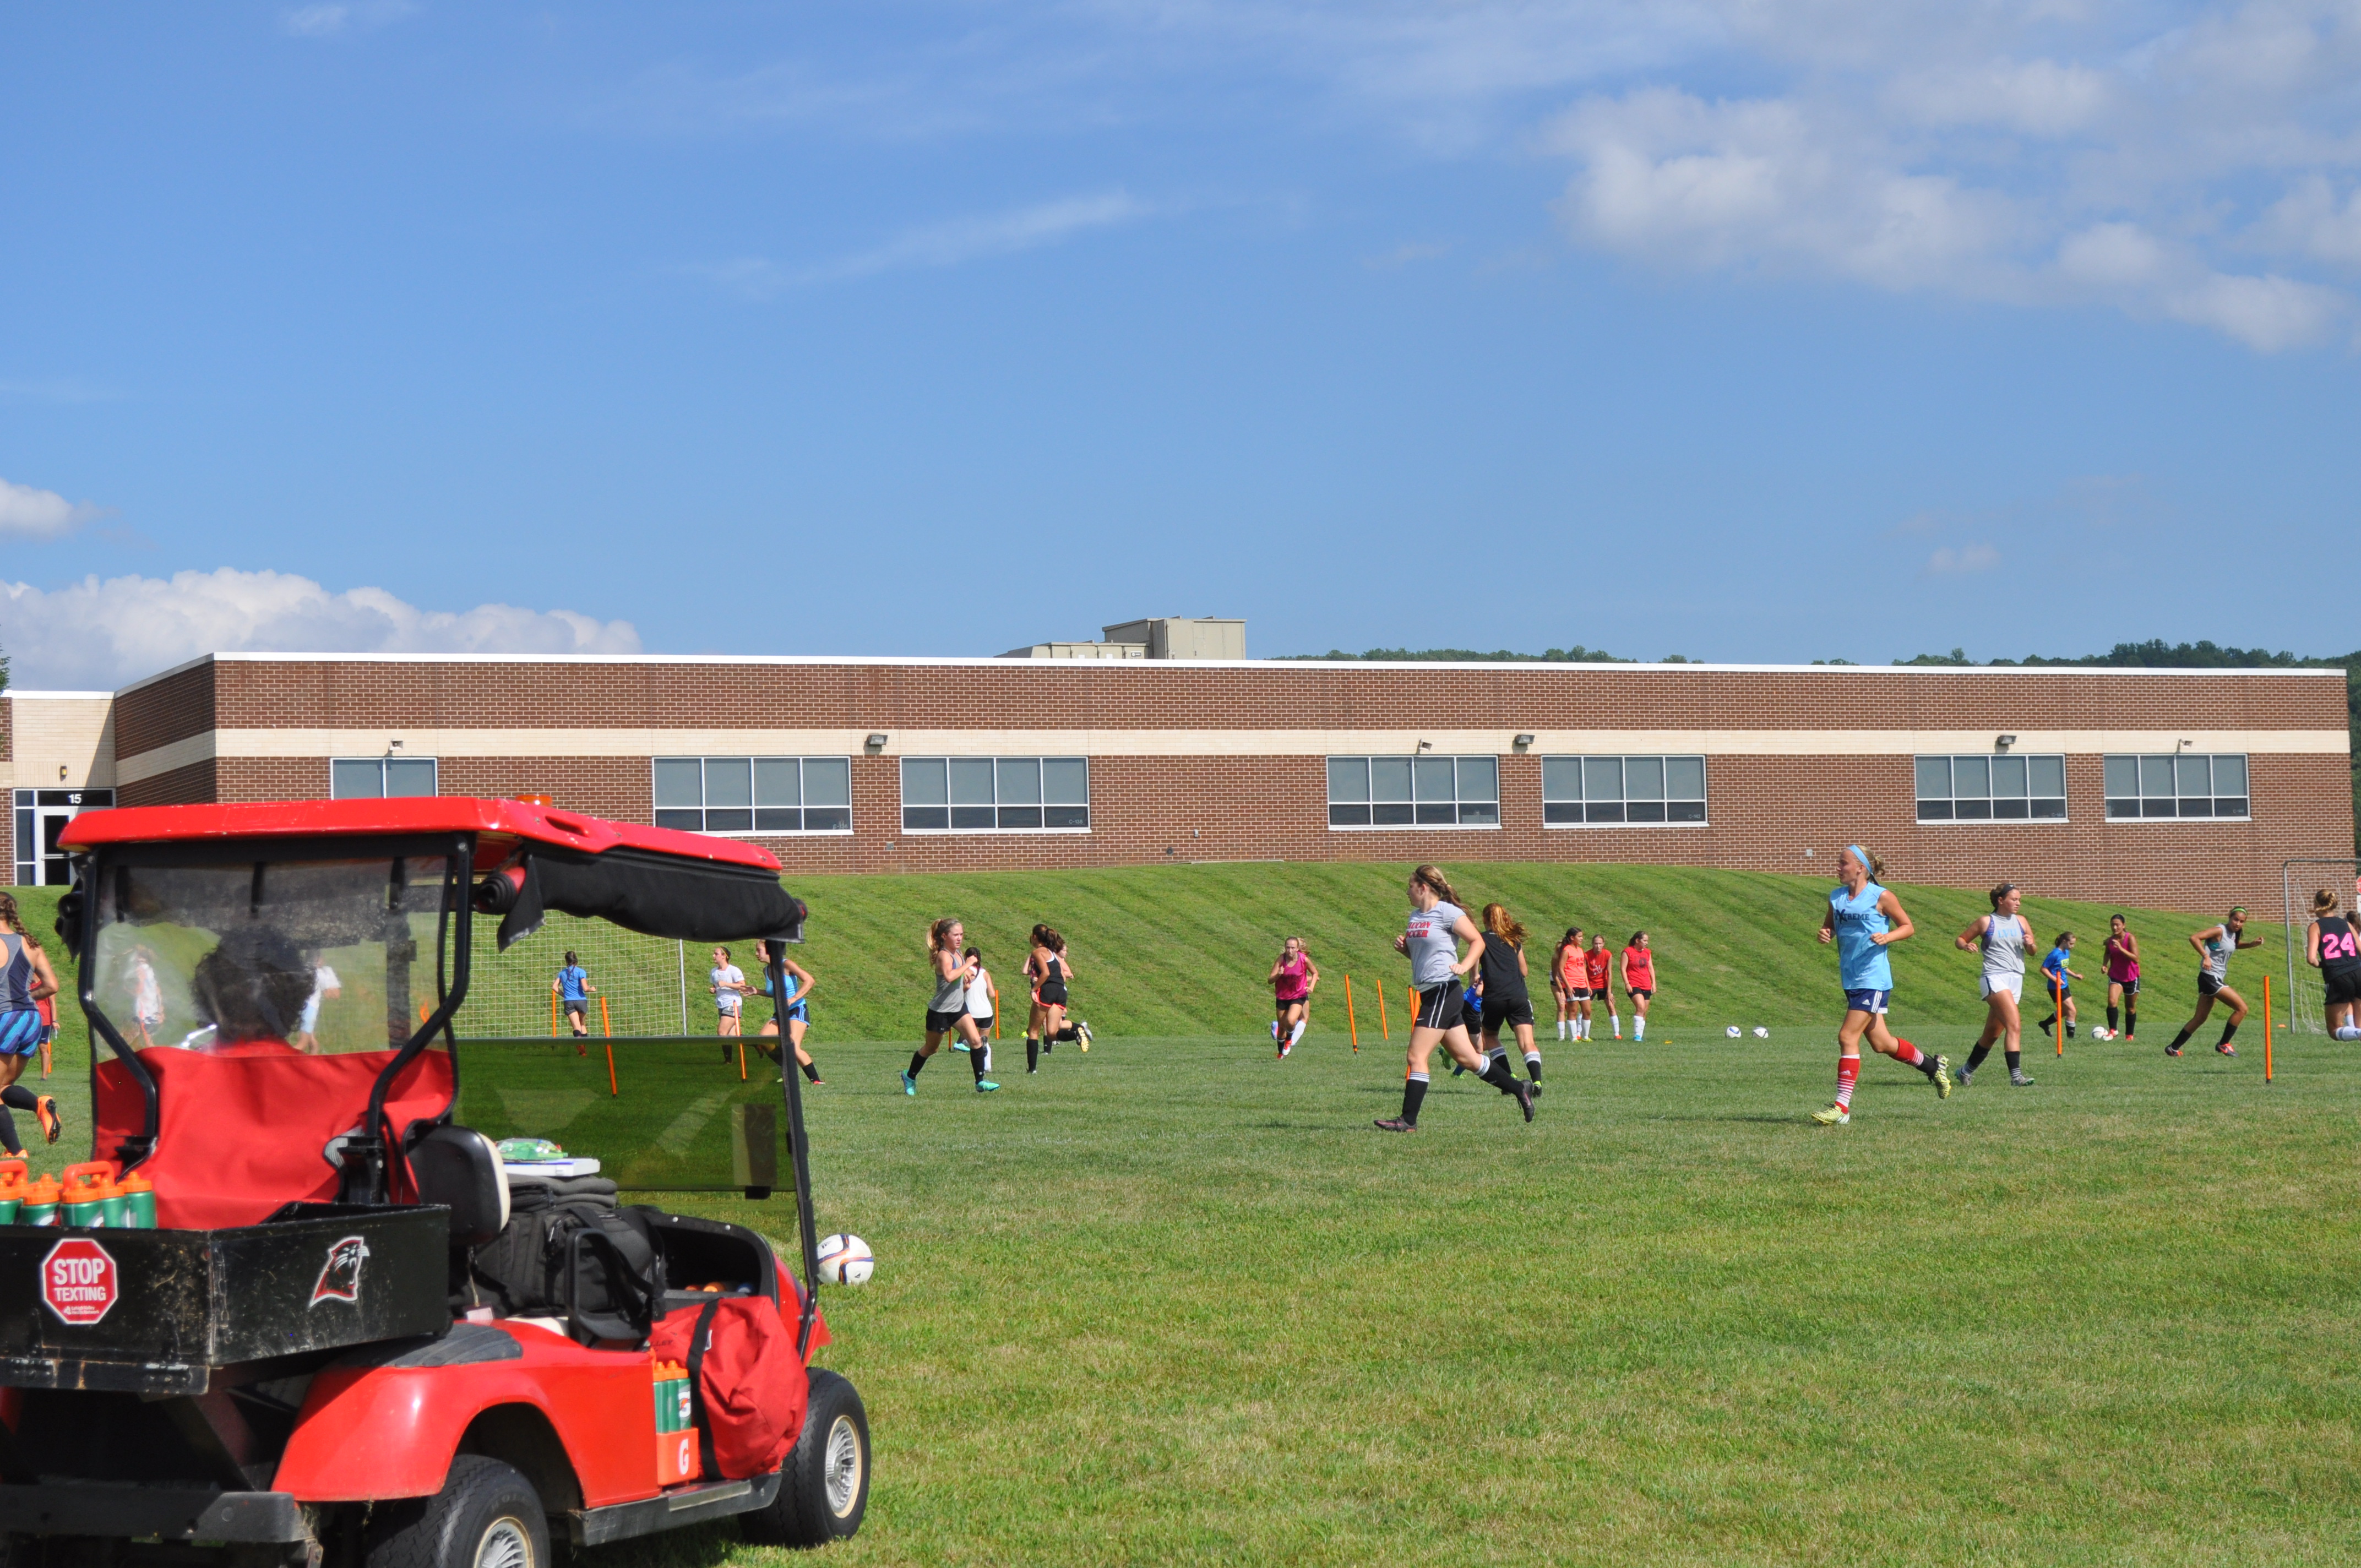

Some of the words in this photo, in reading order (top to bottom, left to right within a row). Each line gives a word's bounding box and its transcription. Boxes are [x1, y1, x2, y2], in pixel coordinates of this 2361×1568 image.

[68, 793, 82, 804] 15
[1997, 928, 2017, 938] LVU
[2322, 932, 2357, 960] 24
[54, 1258, 106, 1285] STOP
[54, 1286, 106, 1302] TEXTING
[678, 1438, 689, 1476] G
